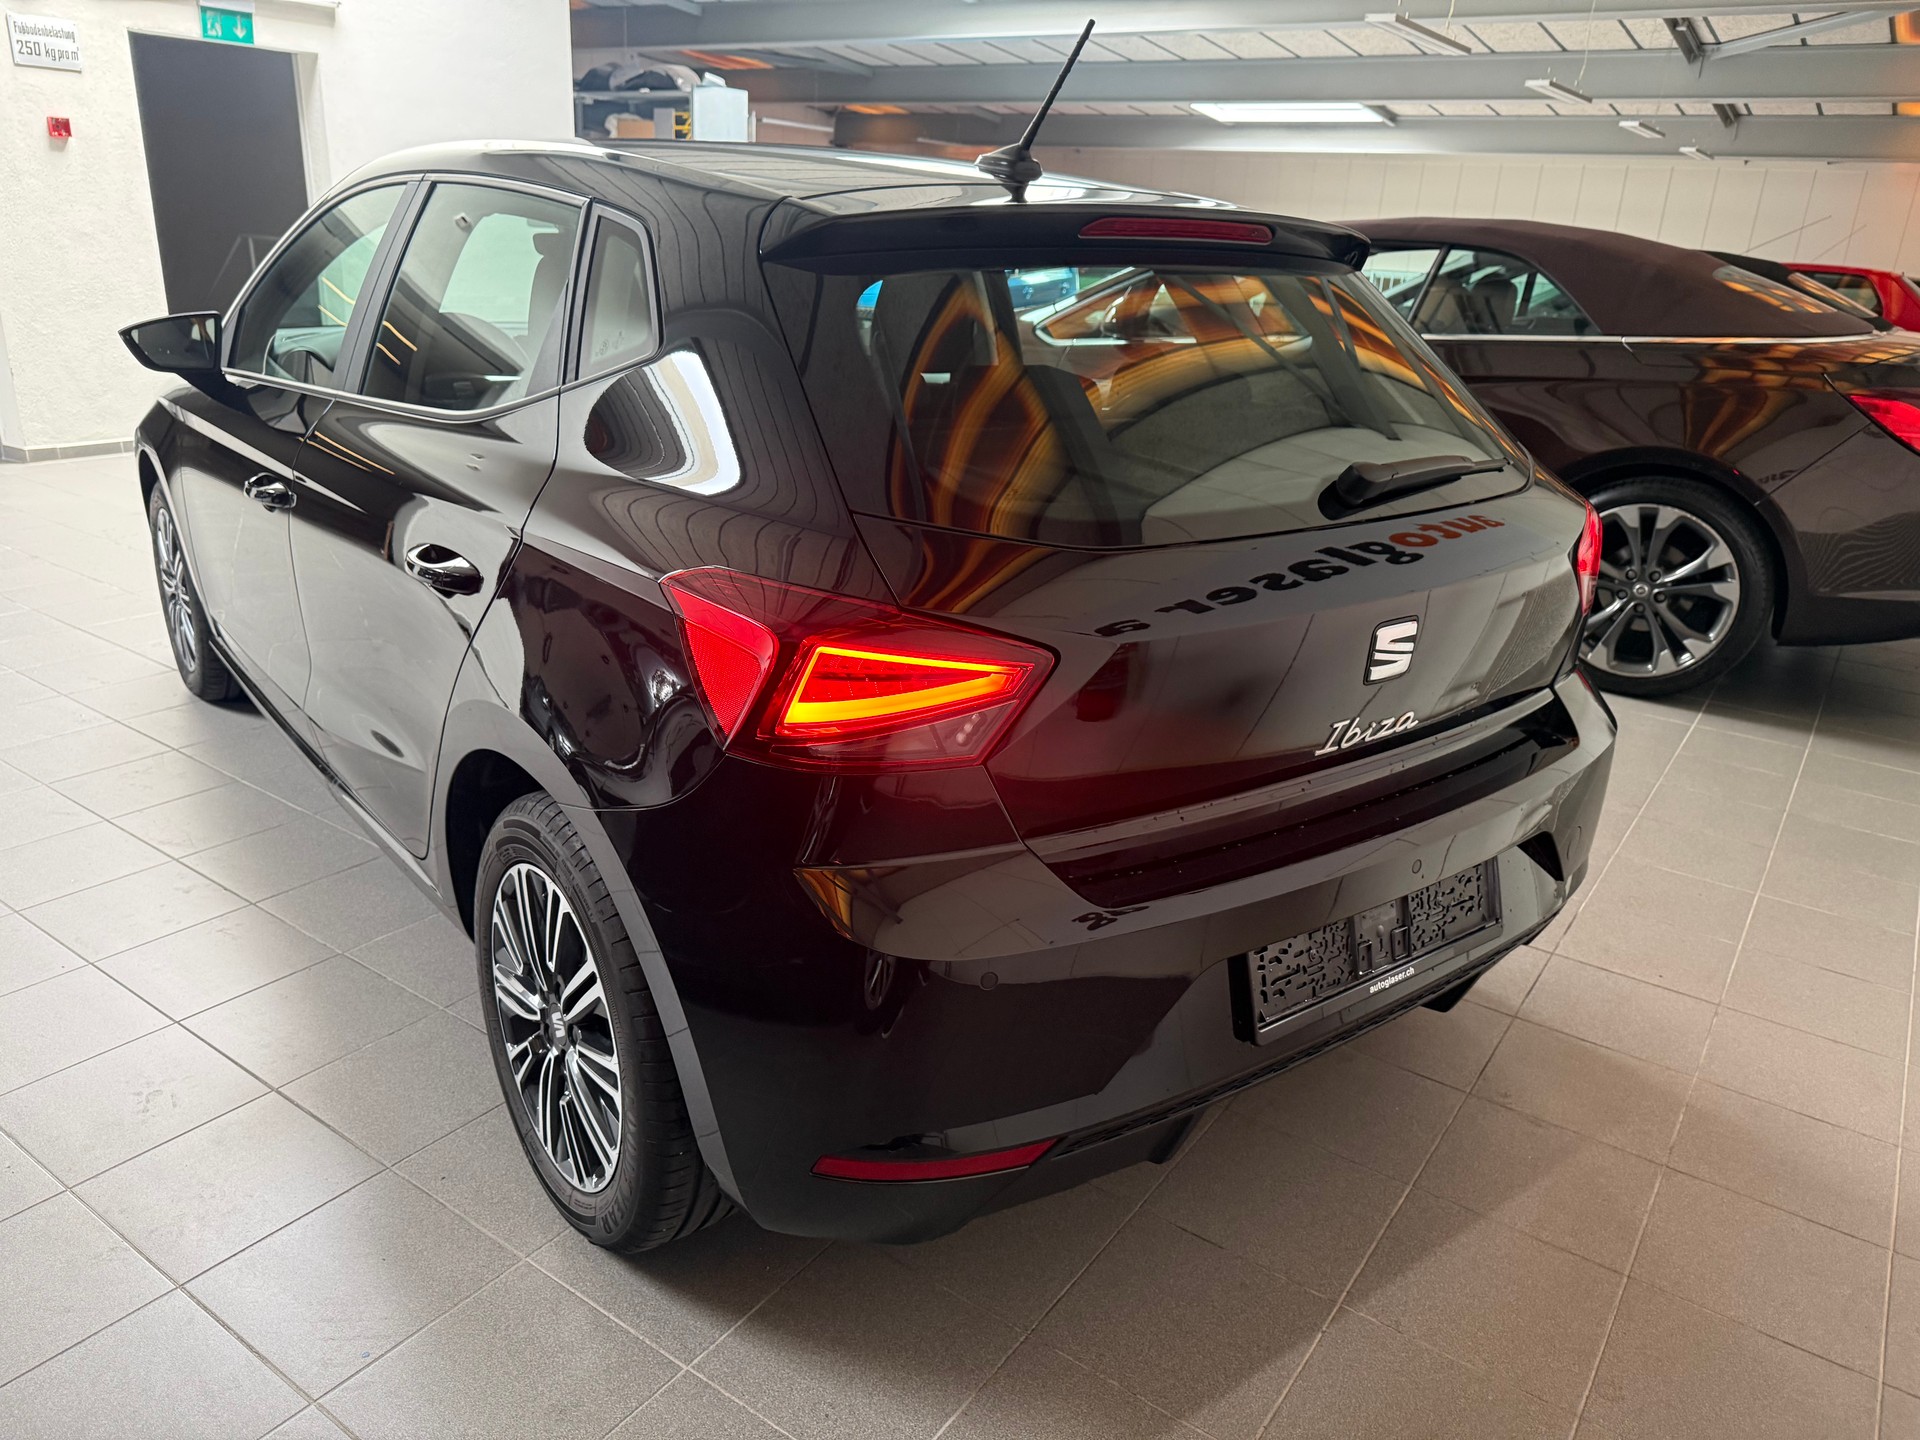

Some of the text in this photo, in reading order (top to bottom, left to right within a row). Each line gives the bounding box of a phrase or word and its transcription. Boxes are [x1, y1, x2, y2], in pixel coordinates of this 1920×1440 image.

[16, 39, 41, 56] 250
[44, 42, 57, 62] kg
[57, 48, 70, 62] pro
[1314, 711, 1419, 757] Ibiza
[1369, 966, 1416, 994] autoglaser.ch
